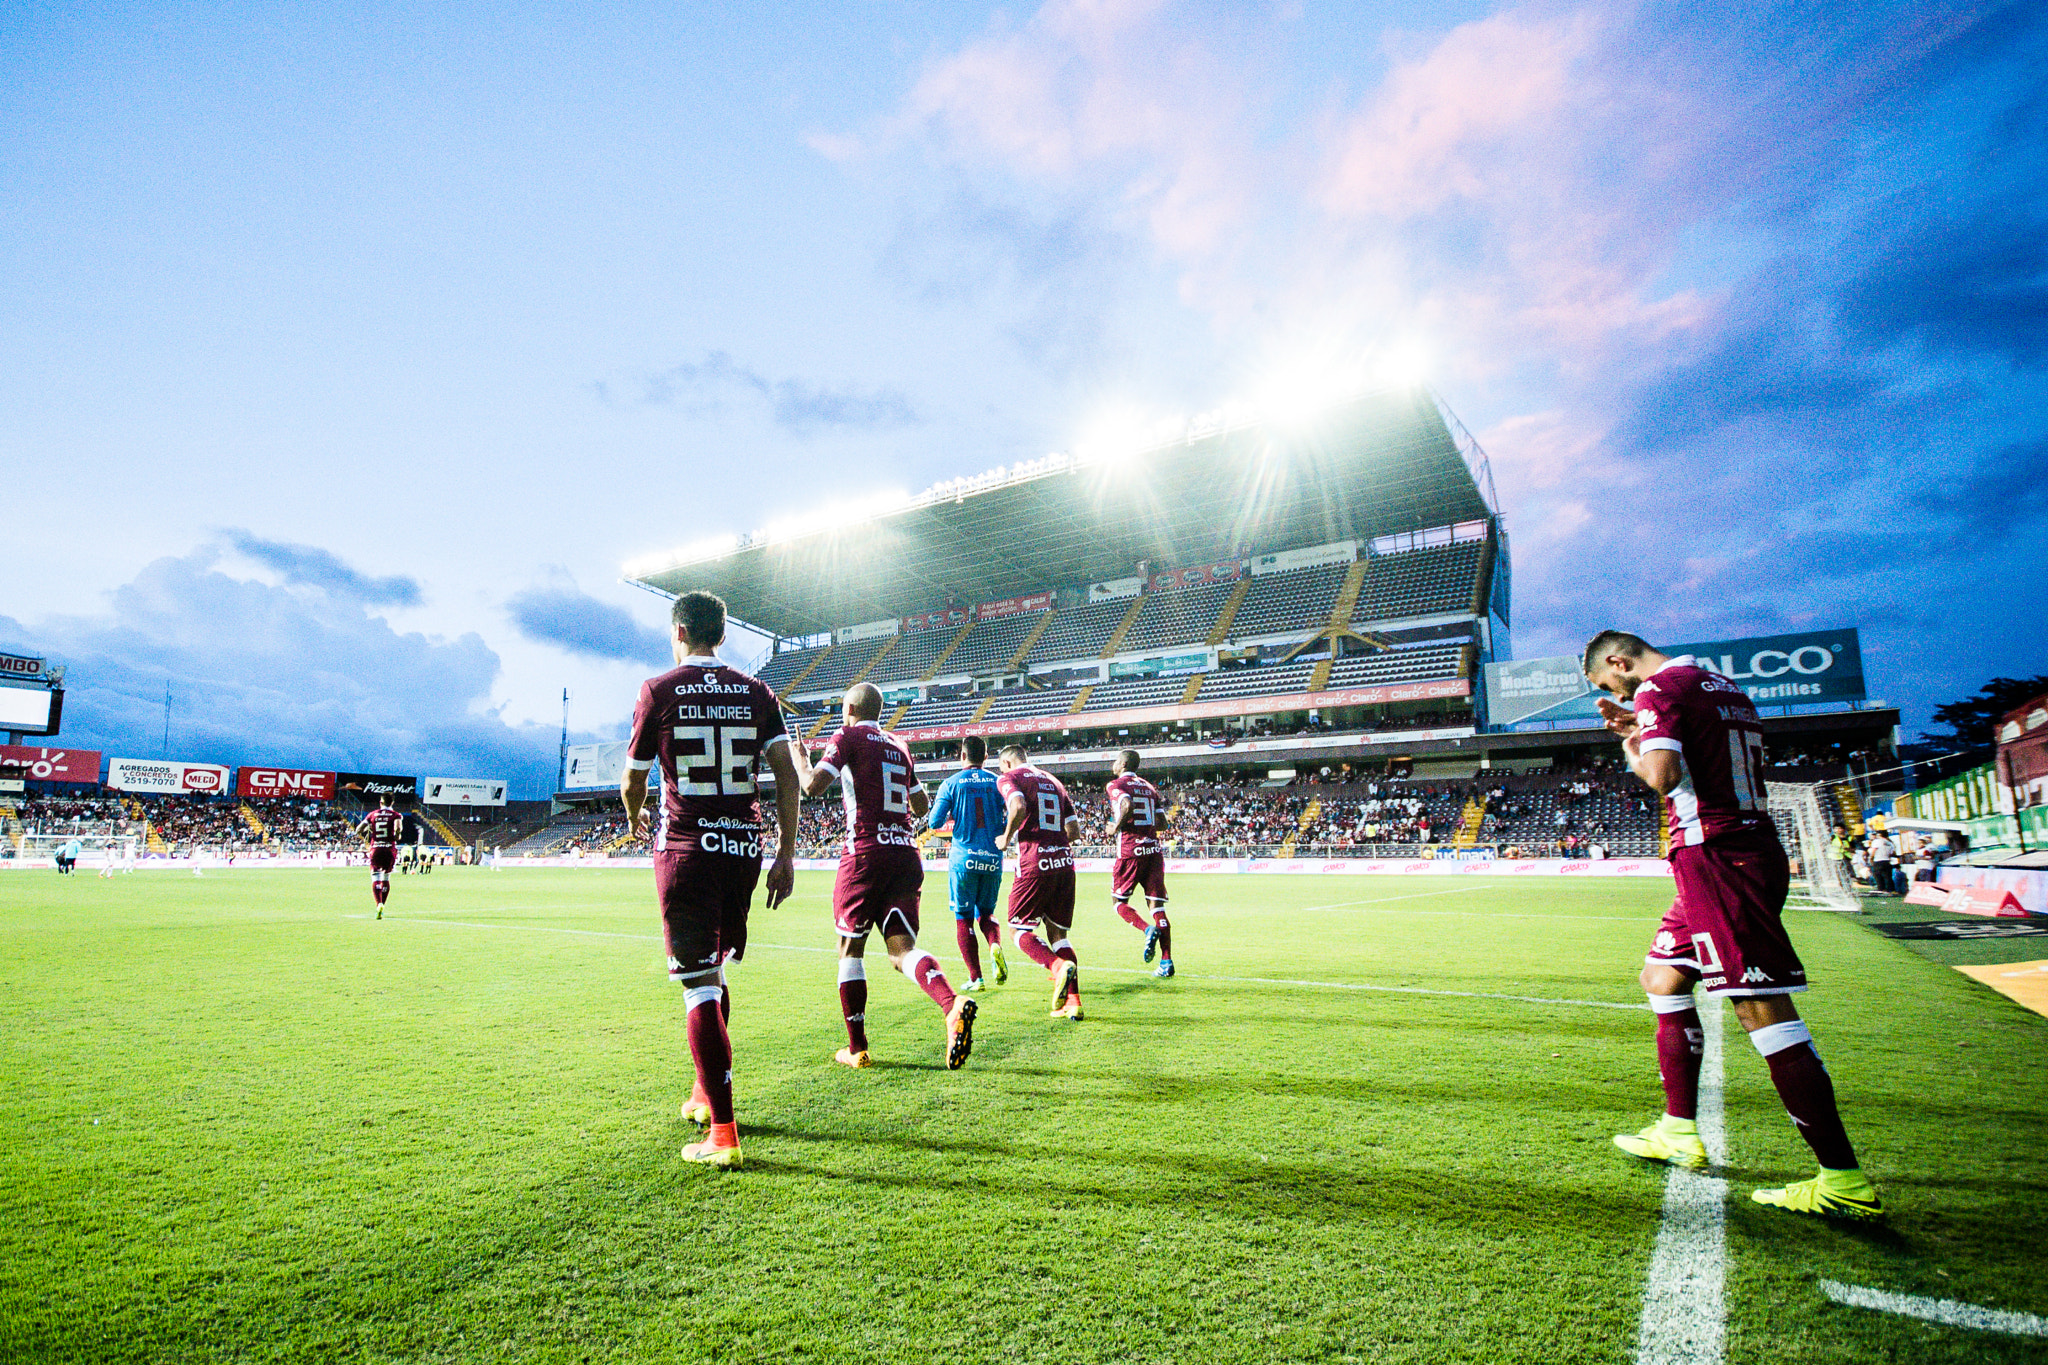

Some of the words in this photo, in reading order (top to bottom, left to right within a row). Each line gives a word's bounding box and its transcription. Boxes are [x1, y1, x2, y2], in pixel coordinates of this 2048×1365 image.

[1696, 645, 1834, 680] ALCO
[675, 683, 750, 695] GATORADE
[1315, 694, 1343, 706] Claro
[1350, 691, 1378, 704] Claro
[1391, 687, 1420, 700] Claro
[1428, 683, 1459, 696] Claro
[1747, 682, 1822, 700] Perfiles
[678, 705, 752, 720] COLINDRES
[673, 726, 758, 796] 26
[884, 749, 901, 762] TITI
[119, 764, 171, 773] AGREGADOS
[129, 770, 178, 779] CONCRETOS
[124, 776, 176, 786] 2519-7070
[188, 775, 215, 784] MECO
[250, 770, 325, 790] GNC
[250, 787, 280, 796] LIVE
[363, 781, 393, 794] Pizza
[393, 784, 415, 794] Hut
[881, 761, 908, 814] 6
[1037, 792, 1061, 832] 8
[1133, 796, 1155, 827] 31
[375, 821, 388, 838] 5
[701, 832, 759, 858] Claro
[877, 831, 918, 849] Claro
[1133, 846, 1161, 856] Claro
[965, 859, 997, 872] Claro
[1038, 856, 1074, 871] Claro
